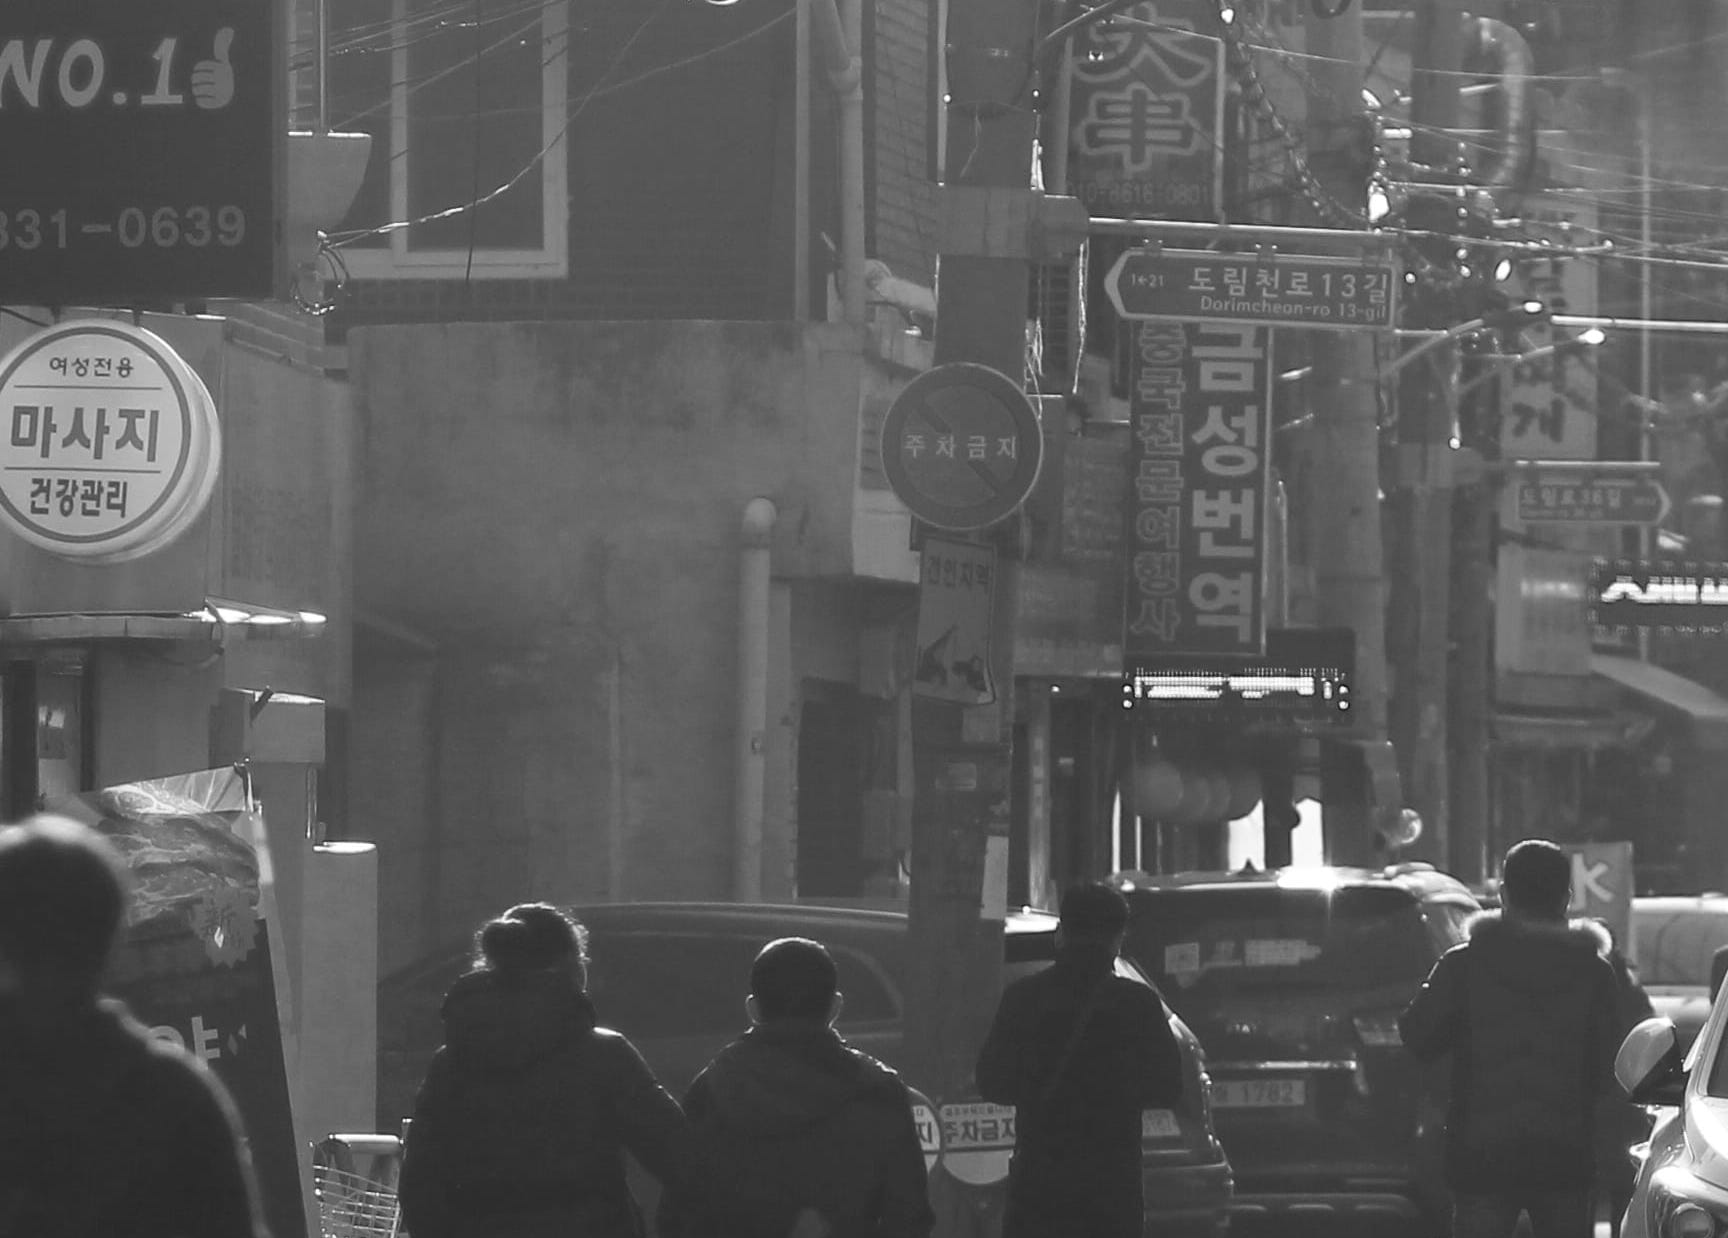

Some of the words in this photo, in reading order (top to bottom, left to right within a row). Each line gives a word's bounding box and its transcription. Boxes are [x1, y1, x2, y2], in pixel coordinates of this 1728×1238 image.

[1188, 267, 1387, 304] 도림천로13길
[1200, 295, 1331, 318] Dorimcheon-ro
[1337, 302, 1388, 322] 13-gil
[48, 356, 136, 380] 여성전용
[10, 404, 162, 463] 마사지
[903, 433, 1017, 460] 주차금지
[29, 476, 129, 519] 건강관리
[1189, 322, 1263, 644] 금성번역
